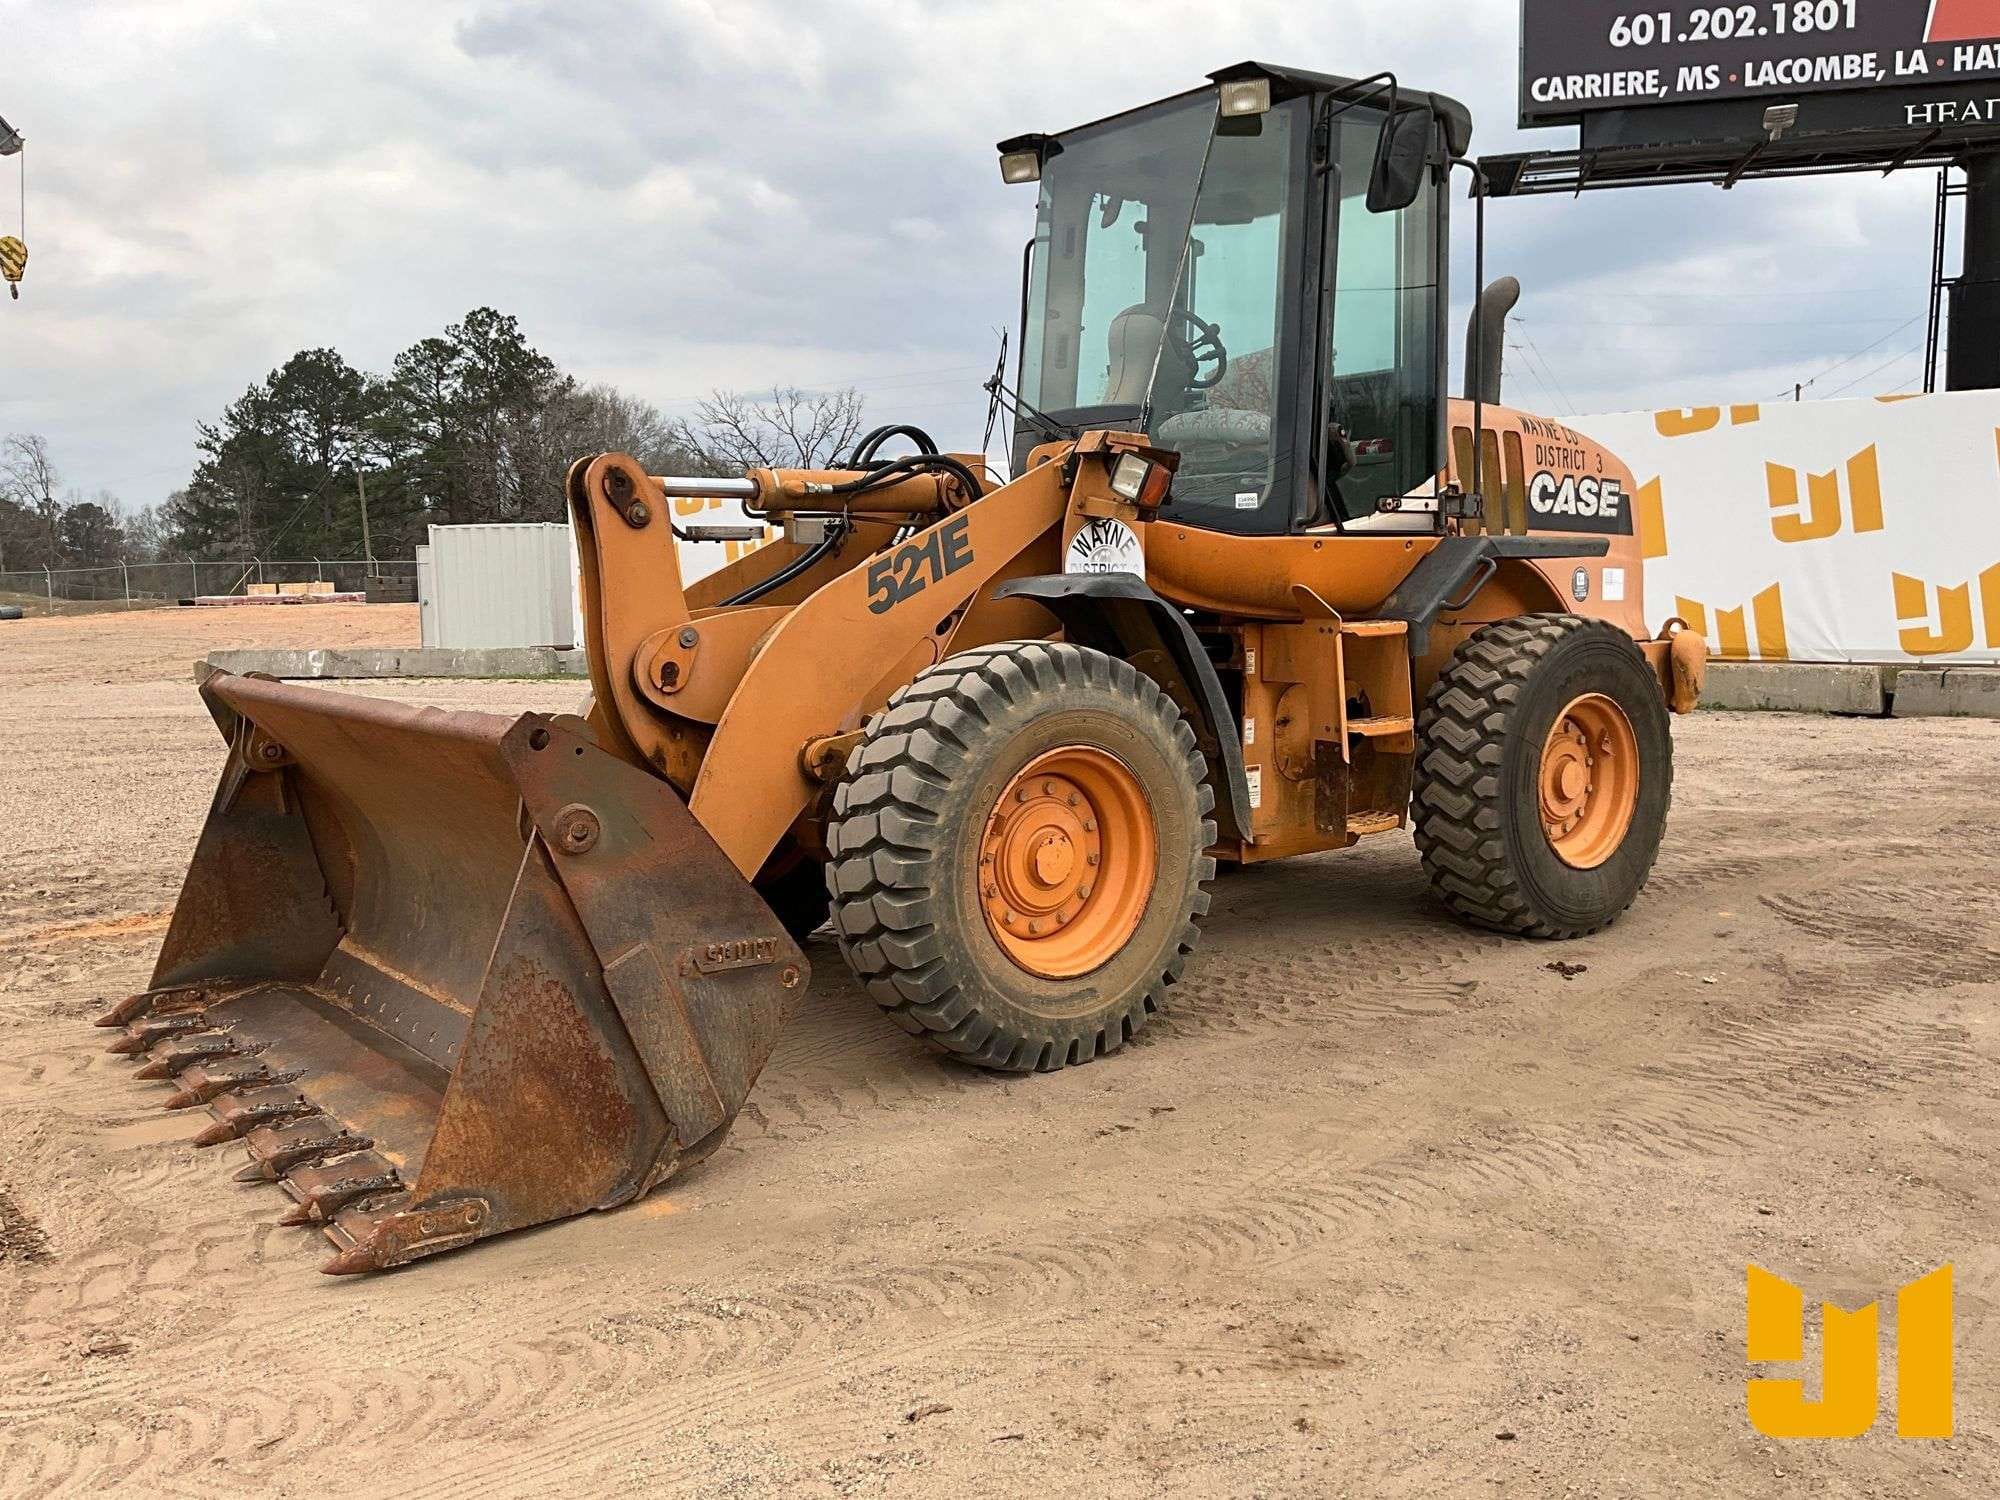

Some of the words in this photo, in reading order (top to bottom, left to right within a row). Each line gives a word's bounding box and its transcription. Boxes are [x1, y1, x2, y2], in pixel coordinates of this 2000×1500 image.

[1609, 0, 1856, 47] 601.202.1801
[1531, 69, 1669, 102] CARRIERE,
[1676, 64, 1721, 92] MS
[1744, 52, 1886, 87] LACOMBE,
[1895, 49, 1929, 75] LA
[1516, 415, 1561, 441] WAYNE
[1560, 426, 1579, 446] CO
[1535, 444, 1586, 471] DISTRICT
[1595, 452, 1604, 473] 3
[1530, 472, 1622, 518] CASE
[1072, 520, 1137, 558] WAYNE
[867, 514, 974, 615] 521E
